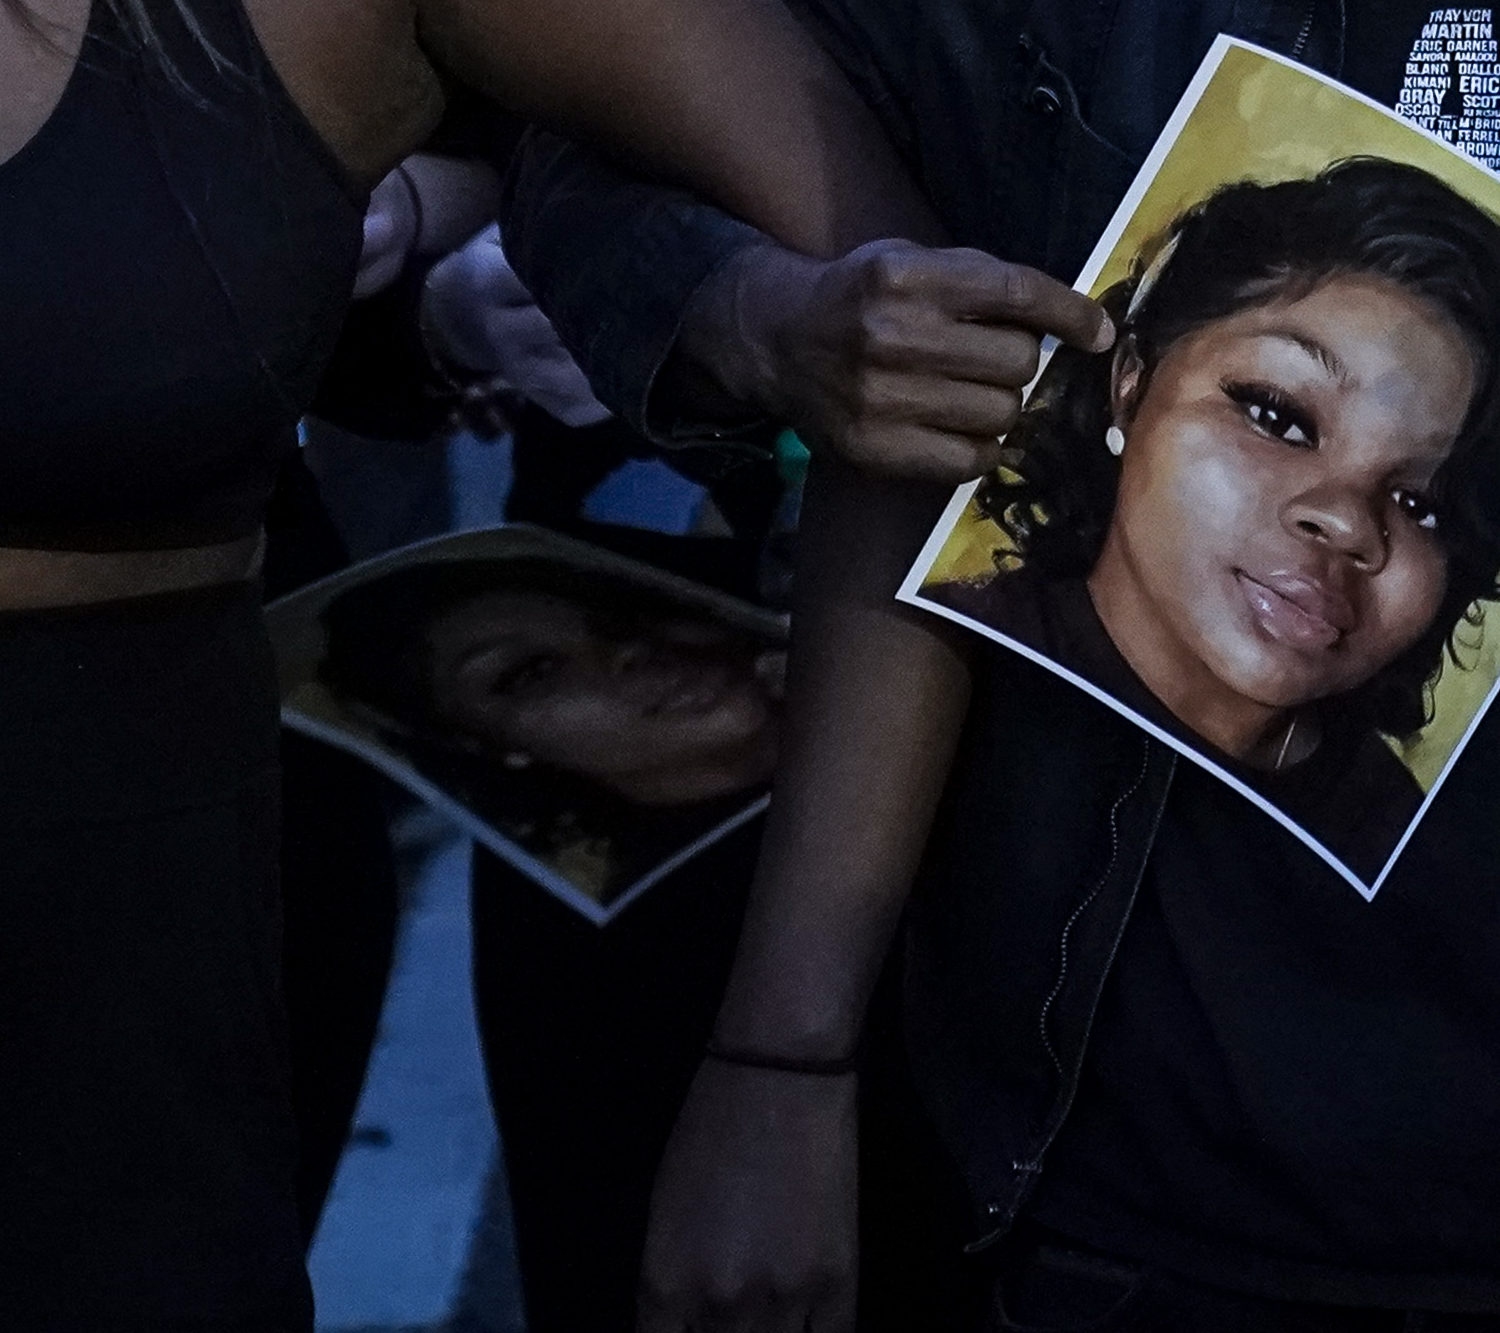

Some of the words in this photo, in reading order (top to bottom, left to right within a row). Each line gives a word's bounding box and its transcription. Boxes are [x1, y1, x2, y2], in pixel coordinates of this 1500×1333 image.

[1421, 23, 1493, 39] MARTIN
[1413, 40, 1443, 52] ERIC
[1446, 40, 1498, 52] GARNER
[1408, 52, 1451, 62] SANDRA
[1405, 63, 1449, 75] BLAND
[1404, 76, 1451, 89] KIMANI
[1459, 76, 1500, 93] ERIC
[1399, 89, 1446, 105] GRAY
[1395, 103, 1440, 116] OSCAR
